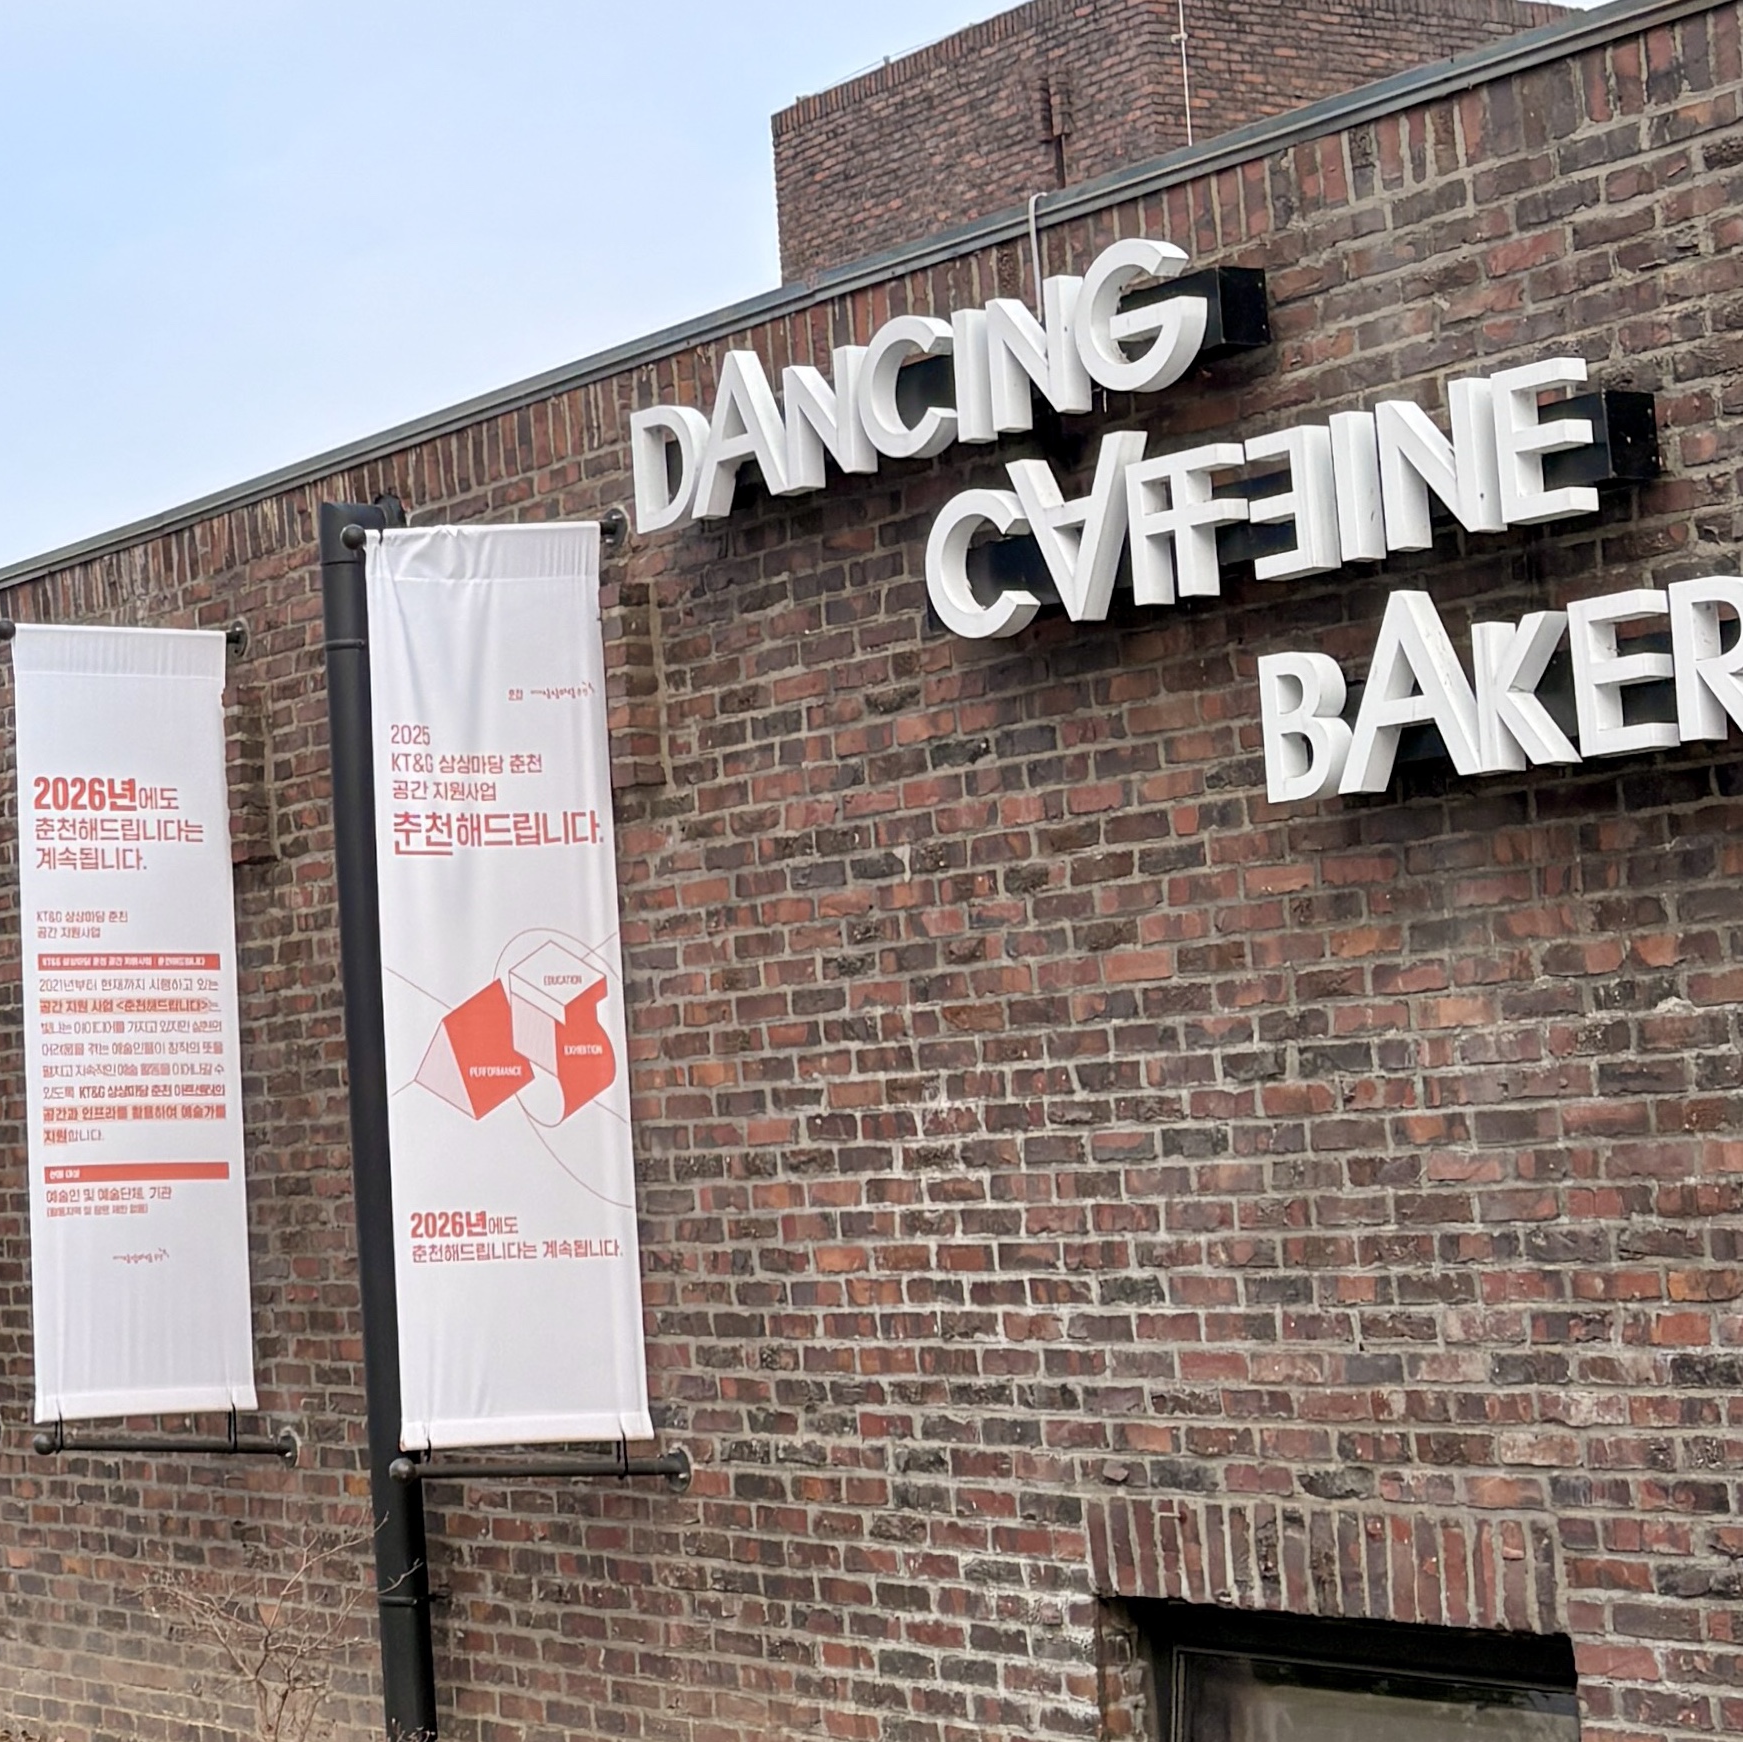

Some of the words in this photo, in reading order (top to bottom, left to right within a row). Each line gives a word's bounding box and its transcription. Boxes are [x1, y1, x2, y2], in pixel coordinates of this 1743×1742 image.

[631, 239, 1207, 534] DANCING
[1259, 576, 1743, 803] BAKER
[391, 724, 431, 745] 2025
[391, 753, 434, 773] KT&G
[438, 753, 504, 775] 상상마당
[510, 753, 543, 774] 춘천
[34, 776, 179, 811] 2026년에도
[392, 780, 428, 801] 공간
[432, 781, 497, 801] 지원사업
[35, 818, 204, 842] 춘천해드립니다는
[36, 848, 147, 870] 계속됩니다.
[37, 911, 62, 922] KT&G
[543, 975, 582, 985] EDUCATION
[469, 1066, 522, 1077] PERFORMANCE
[79, 1085, 105, 1098] KT&G
[410, 1211, 519, 1239] 2026년에도
[412, 1241, 537, 1263] 춘천해드립니다는
[543, 1239, 623, 1259] 계속됩니다.
